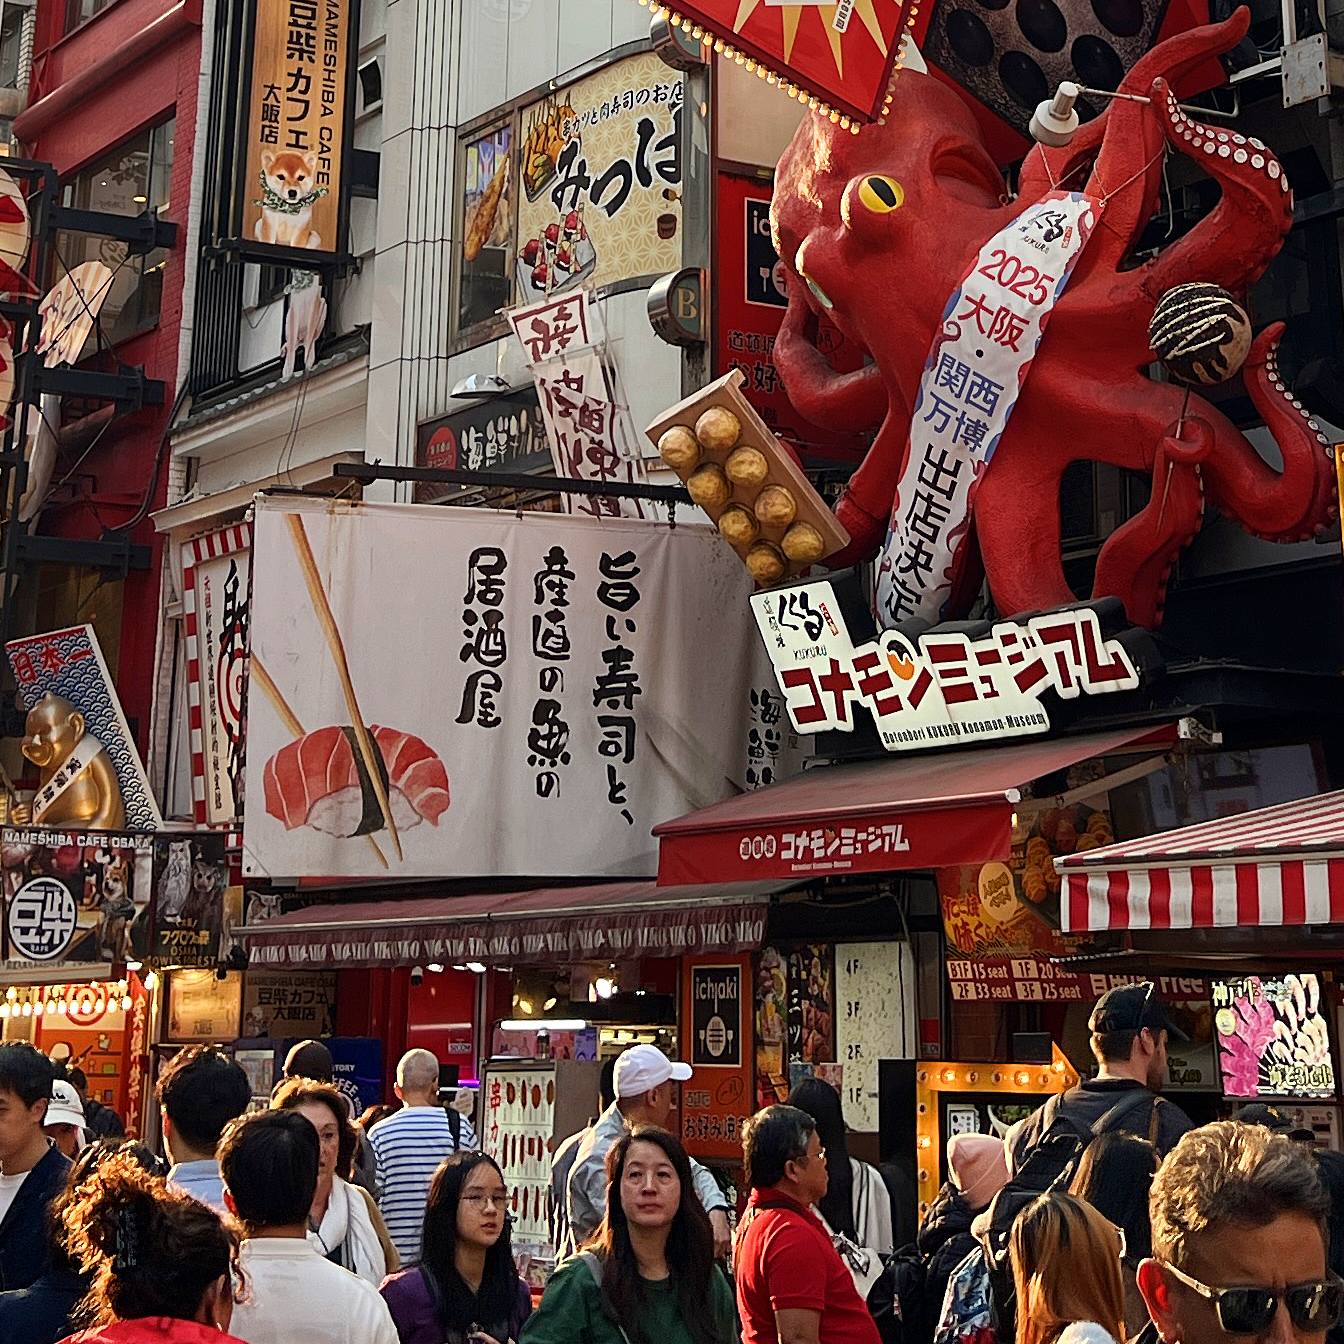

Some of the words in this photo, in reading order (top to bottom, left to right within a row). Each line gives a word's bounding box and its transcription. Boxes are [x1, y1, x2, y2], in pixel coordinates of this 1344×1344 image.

[259, 82, 282, 146] 大阪店
[315, 126, 334, 186] CAFE
[977, 248, 1056, 306] 2025
[957, 293, 1030, 354] 大阪
[933, 351, 1006, 419] 関西
[922, 390, 992, 453] 万博
[885, 442, 965, 624] 出店決定
[12, 640, 94, 685] 日本一
[455, 546, 508, 728] 居酒屋
[527, 545, 576, 799] 産直の魚の
[592, 550, 642, 825] 旨い寿司と、
[779, 619, 1133, 727] コナモンミュージアム
[961, 712, 1047, 736] Konamon-Museum
[3, 831, 74, 849] MAMESHIBA
[76, 834, 109, 849] CAFE
[110, 836, 152, 850] OSAKA
[780, 823, 911, 861] コナモンミュージアム
[257, 986, 328, 1006] 豆柴カフェ
[948, 961, 972, 979] B1F
[973, 961, 986, 980] 15
[987, 964, 1009, 980] seat
[1017, 960, 1032, 978] 1F
[1038, 962, 1054, 979] 20
[957, 983, 971, 1000] 2F
[976, 983, 990, 1000] 33
[990, 984, 1012, 1000] seat
[1021, 983, 1037, 999] 3F
[1043, 983, 1058, 999] 25
[1059, 984, 1083, 1000] seat
[846, 1001, 862, 1018] 3F
[847, 1044, 862, 1061] 2F
[848, 1087, 863, 1104] 1F
